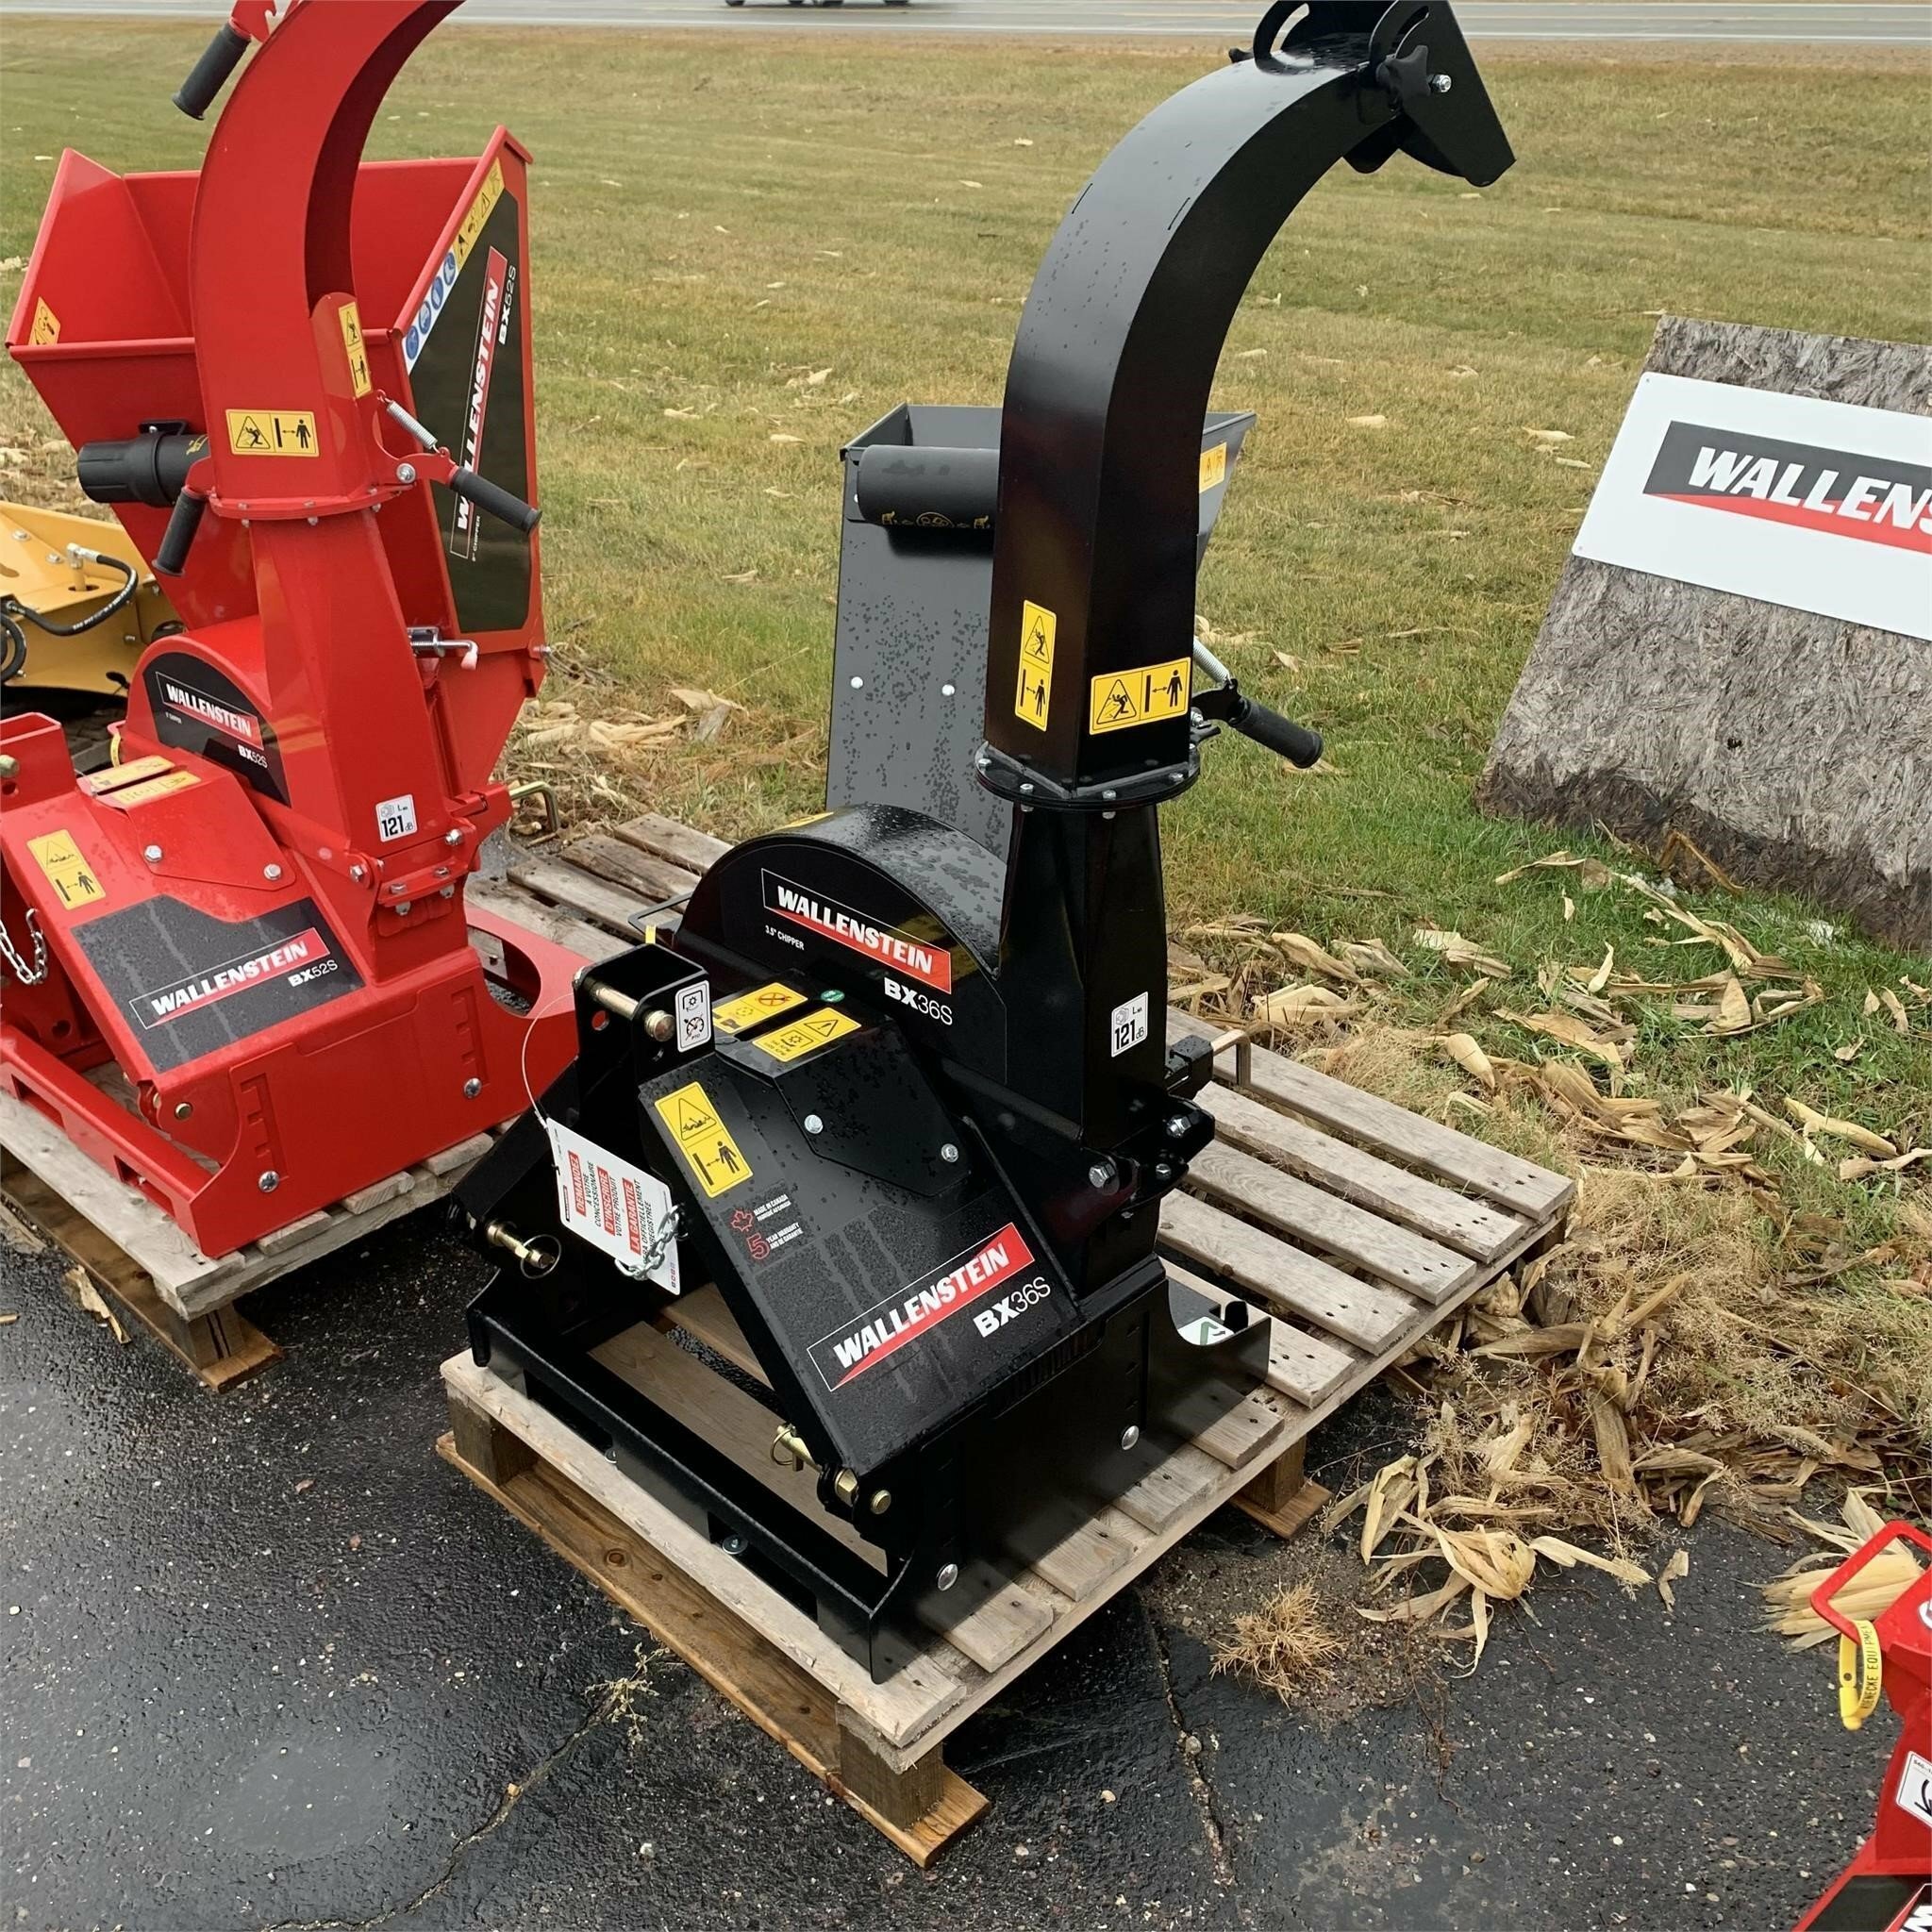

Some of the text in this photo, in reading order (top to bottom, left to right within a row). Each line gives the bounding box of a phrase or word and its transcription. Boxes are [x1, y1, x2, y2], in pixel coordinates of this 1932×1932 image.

[499, 265, 516, 345] BX52S
[458, 277, 498, 529] WLLENSTEIN
[166, 683, 252, 738] WALLENSTEIN
[238, 744, 268, 769] BX52S
[382, 815, 404, 837] 121
[777, 885, 933, 974] WALLENSTEIN
[777, 930, 805, 951] CHIPPER
[151, 941, 308, 1016] WALLENSTEIN
[288, 959, 338, 988] BX52S
[884, 977, 953, 1025] BX36S
[1115, 1019, 1135, 1050] 121
[570, 1154, 585, 1214] DEMANDEZ
[583, 1174, 591, 1199] VOTRE
[598, 1169, 614, 1233] D'INSCRIRE
[609, 1177, 622, 1236] VOTRE PRODUIT
[634, 1178, 648, 1244] OFFICIELLEMENT
[624, 1180, 641, 1253] LA GARANTIE
[746, 1232, 771, 1259] 5
[833, 1242, 1009, 1368] WALLENSTEIN
[973, 1276, 1051, 1338] BX36S
